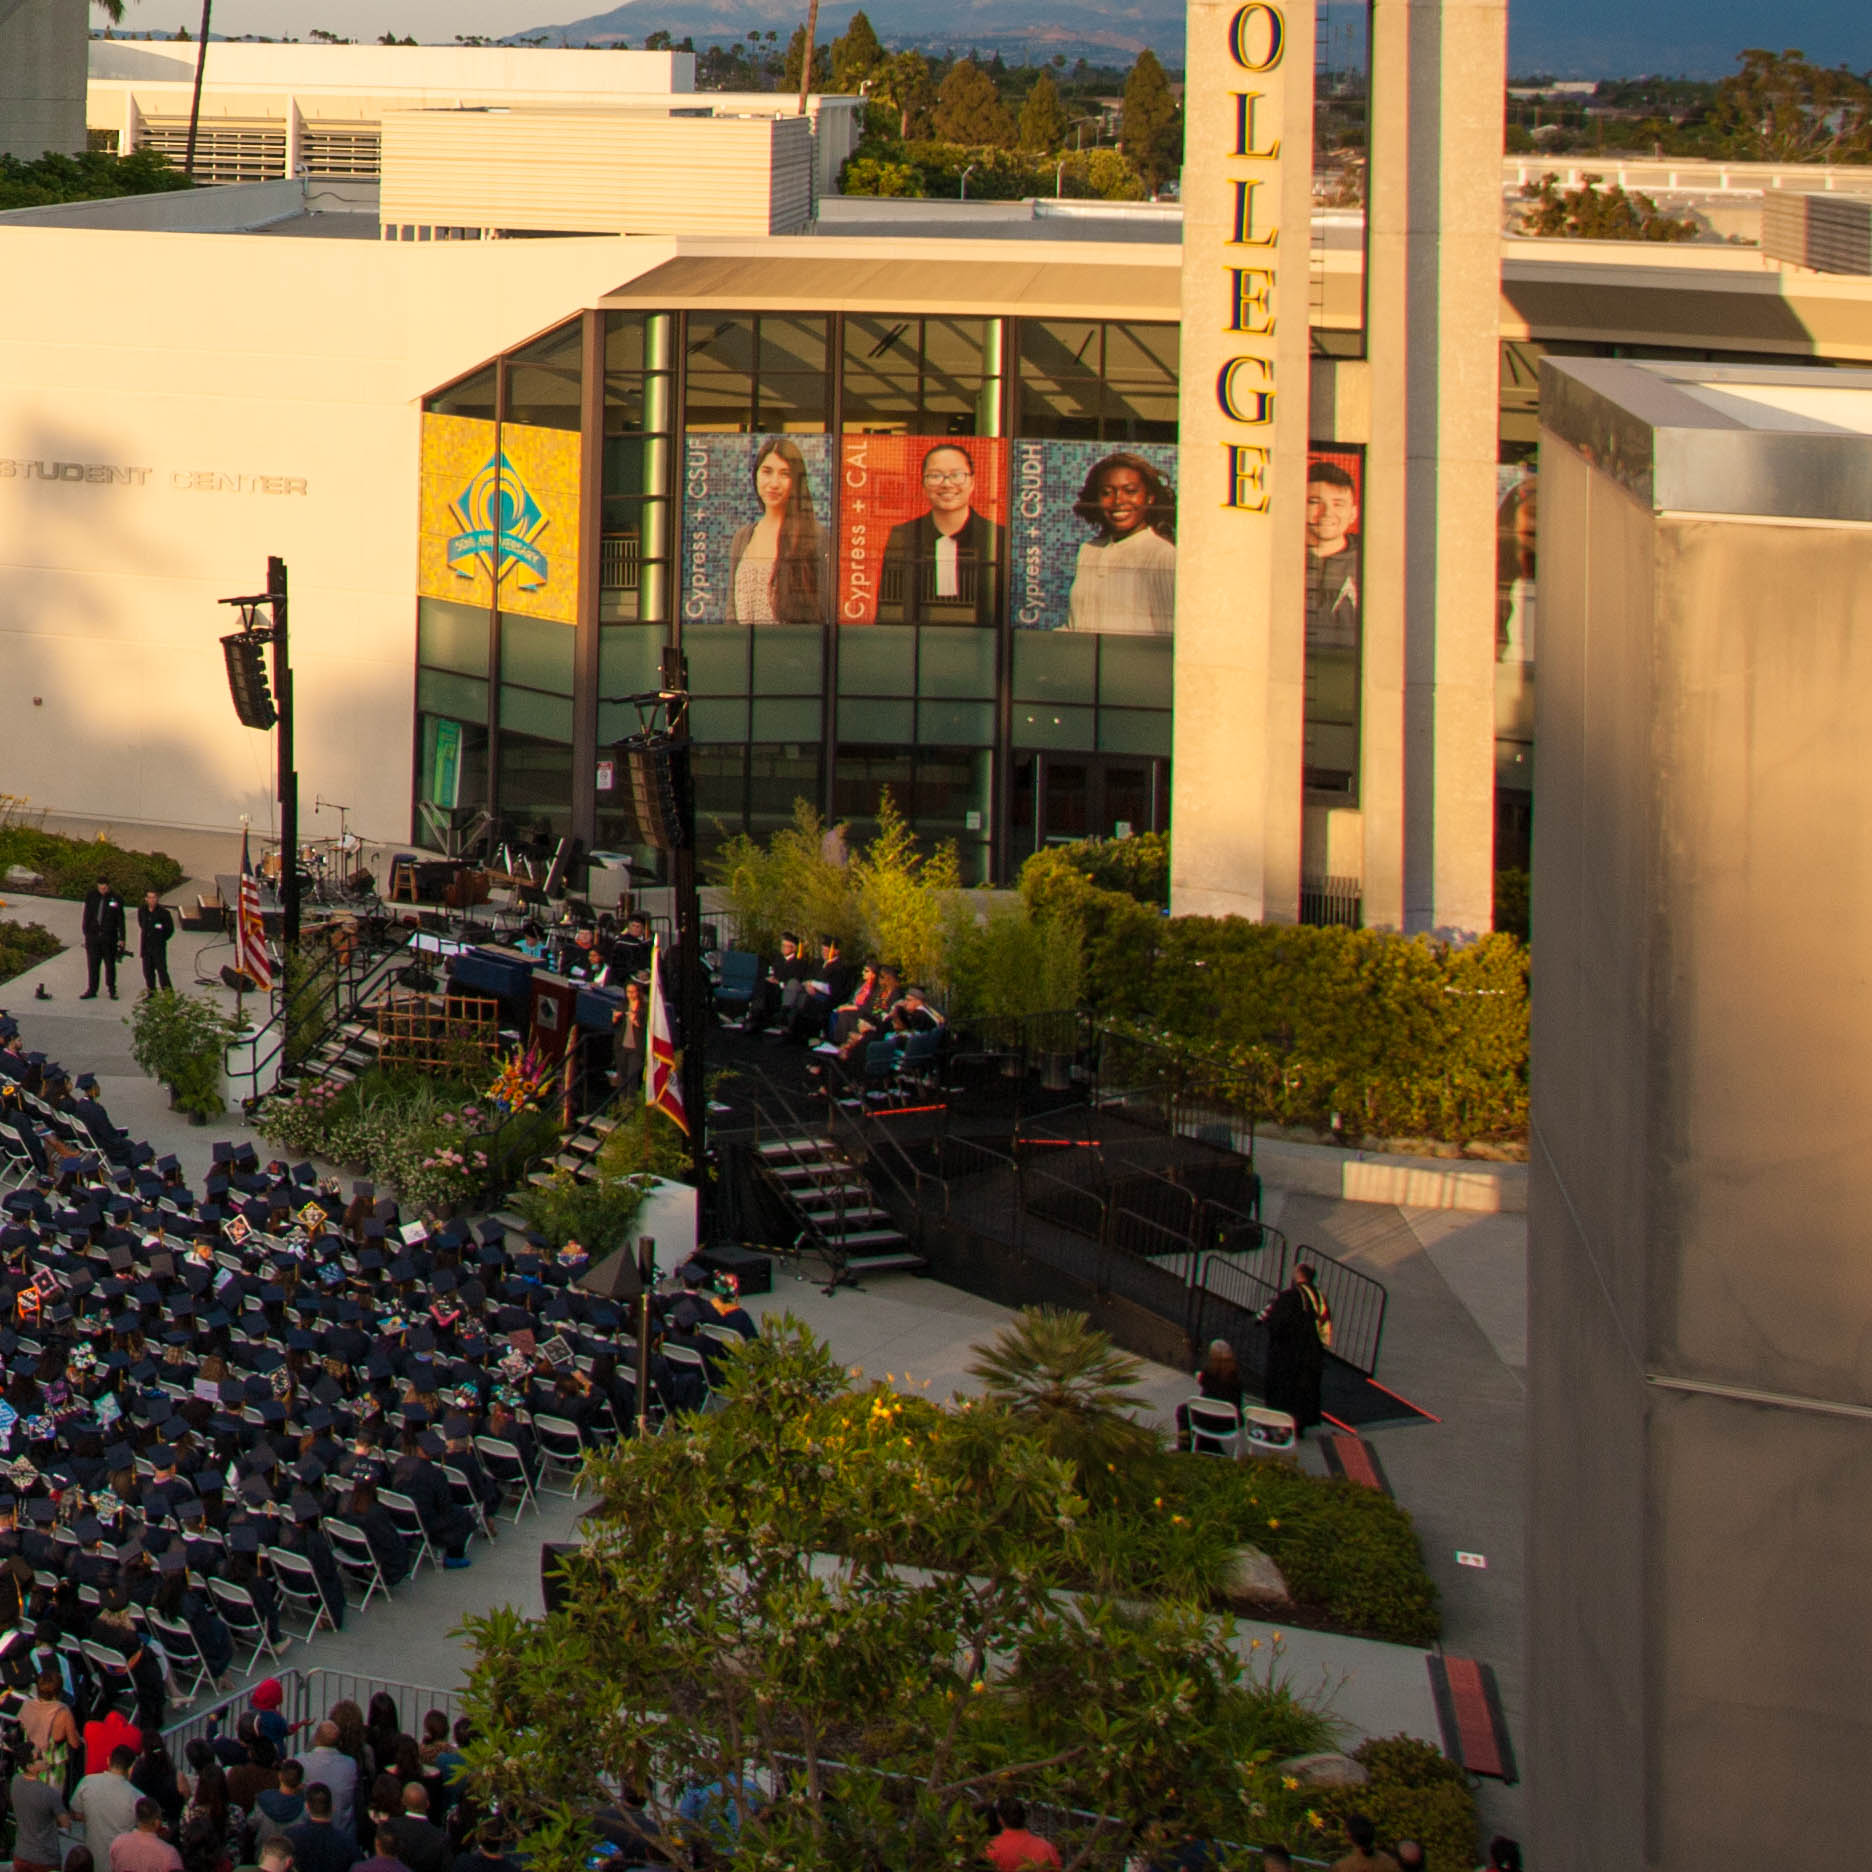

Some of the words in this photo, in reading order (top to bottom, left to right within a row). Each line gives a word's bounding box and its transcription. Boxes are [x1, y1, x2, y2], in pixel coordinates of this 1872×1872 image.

[171, 470, 308, 497] CENTER
[687, 437, 710, 499] CSUF
[846, 440, 868, 489] CAL
[1019, 444, 1043, 518] CSUDH
[684, 531, 712, 619] Cypress
[844, 525, 871, 619] Cypress
[1018, 546, 1046, 624] Cypress
